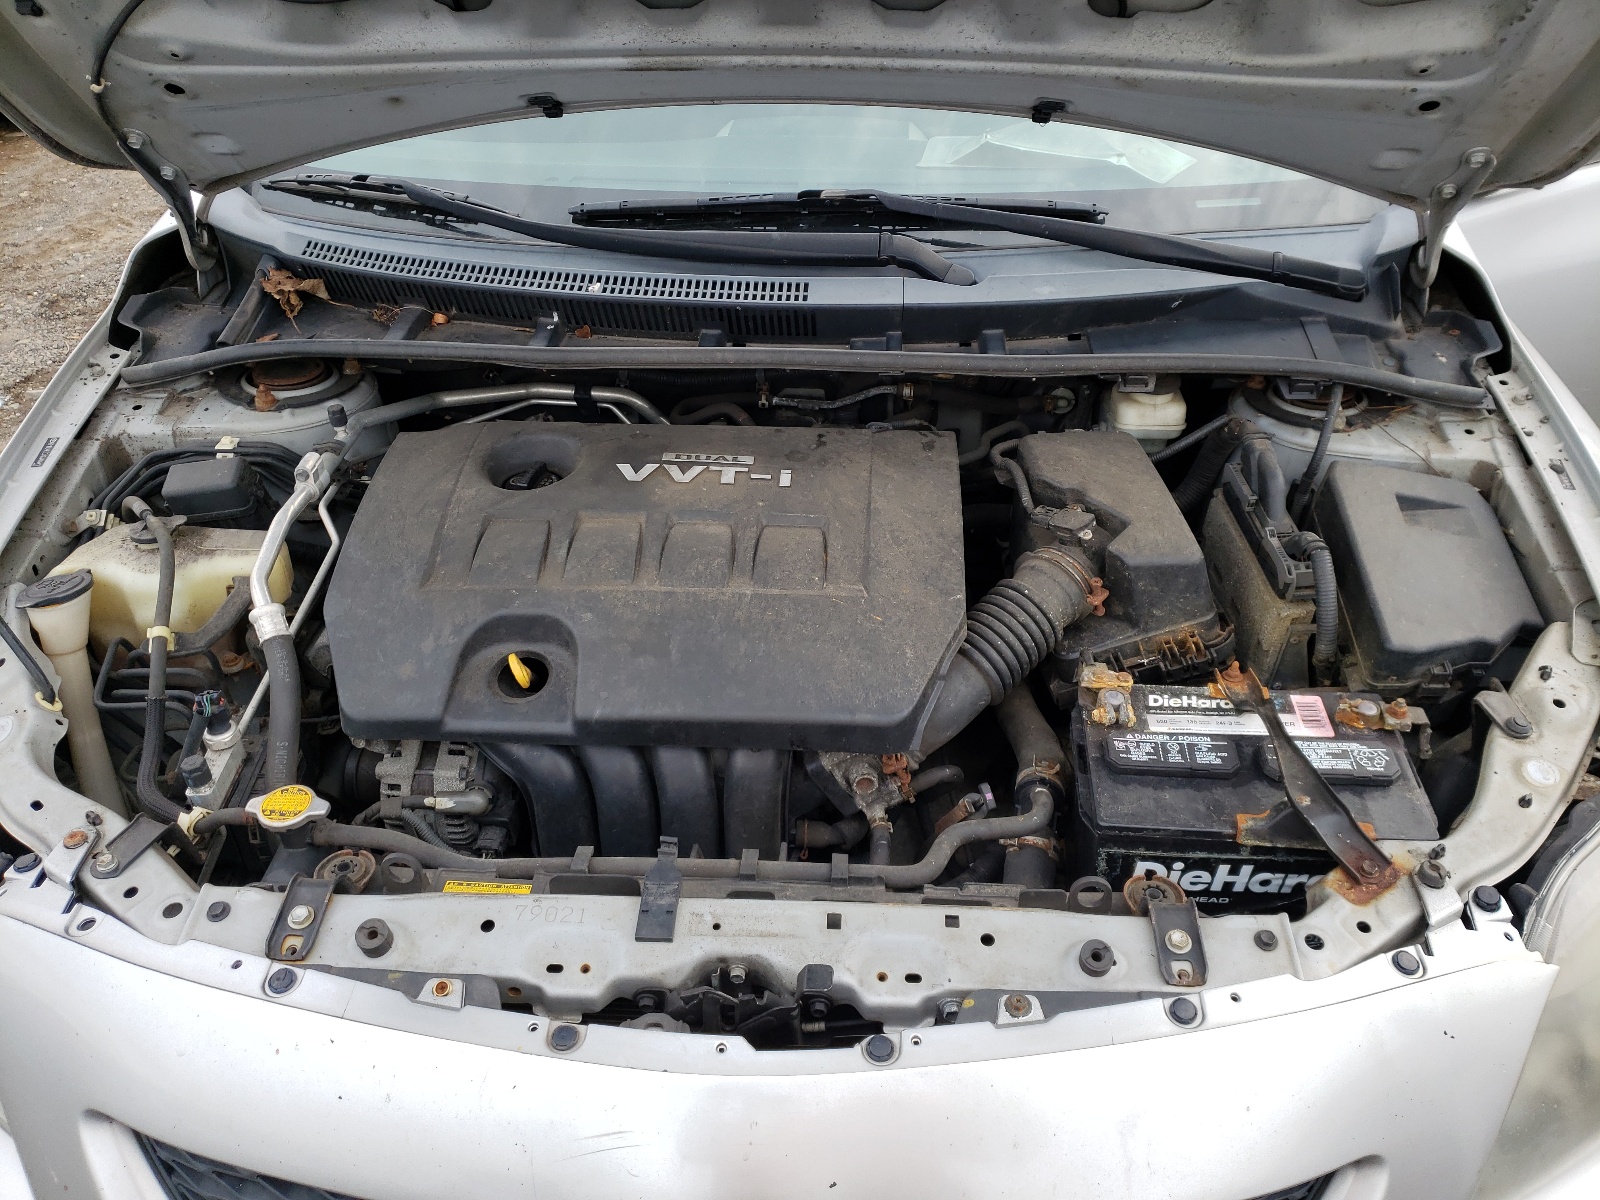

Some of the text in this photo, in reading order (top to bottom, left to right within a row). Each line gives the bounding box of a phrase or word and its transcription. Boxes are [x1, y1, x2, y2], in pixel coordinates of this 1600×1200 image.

[674, 453, 747, 463] DUAL
[615, 463, 792, 487] VVT-i
[1134, 733, 1170, 741] DANGER
[1132, 861, 1328, 894] DieHar
[515, 904, 588, 924] 79021
